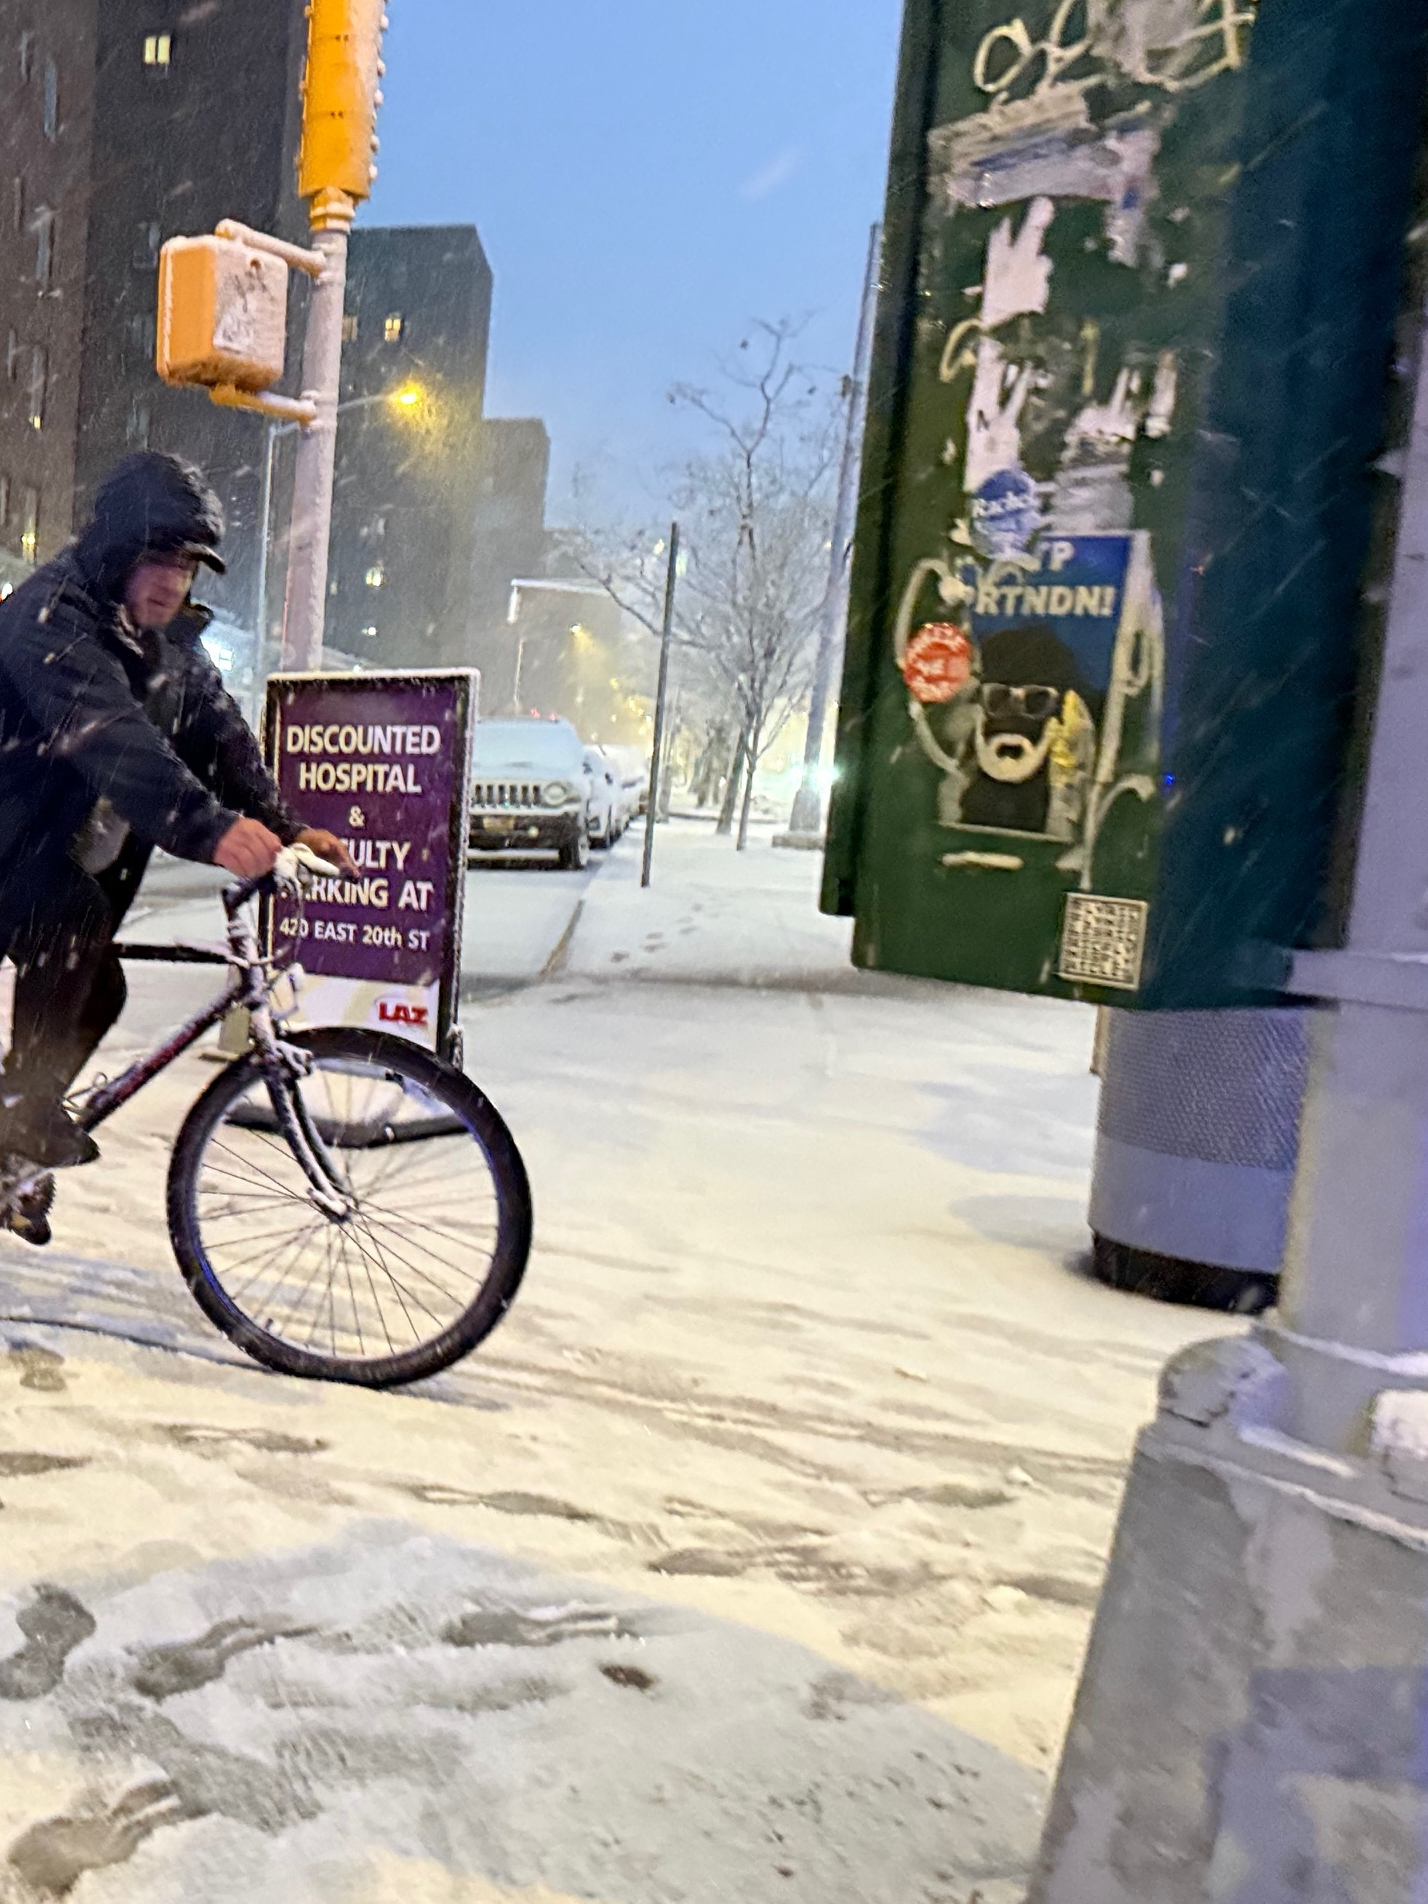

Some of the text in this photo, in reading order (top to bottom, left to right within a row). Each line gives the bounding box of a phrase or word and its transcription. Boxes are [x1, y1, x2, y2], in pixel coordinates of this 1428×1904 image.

[286, 724, 441, 755] DISCOUNTED
[299, 762, 422, 793] HOSPITAL
[348, 805, 366, 828] &
[398, 880, 434, 911] AT
[314, 920, 358, 943] EAST
[362, 924, 403, 948] 20th
[408, 929, 431, 951] ST
[378, 1002, 429, 1027] LAZ
